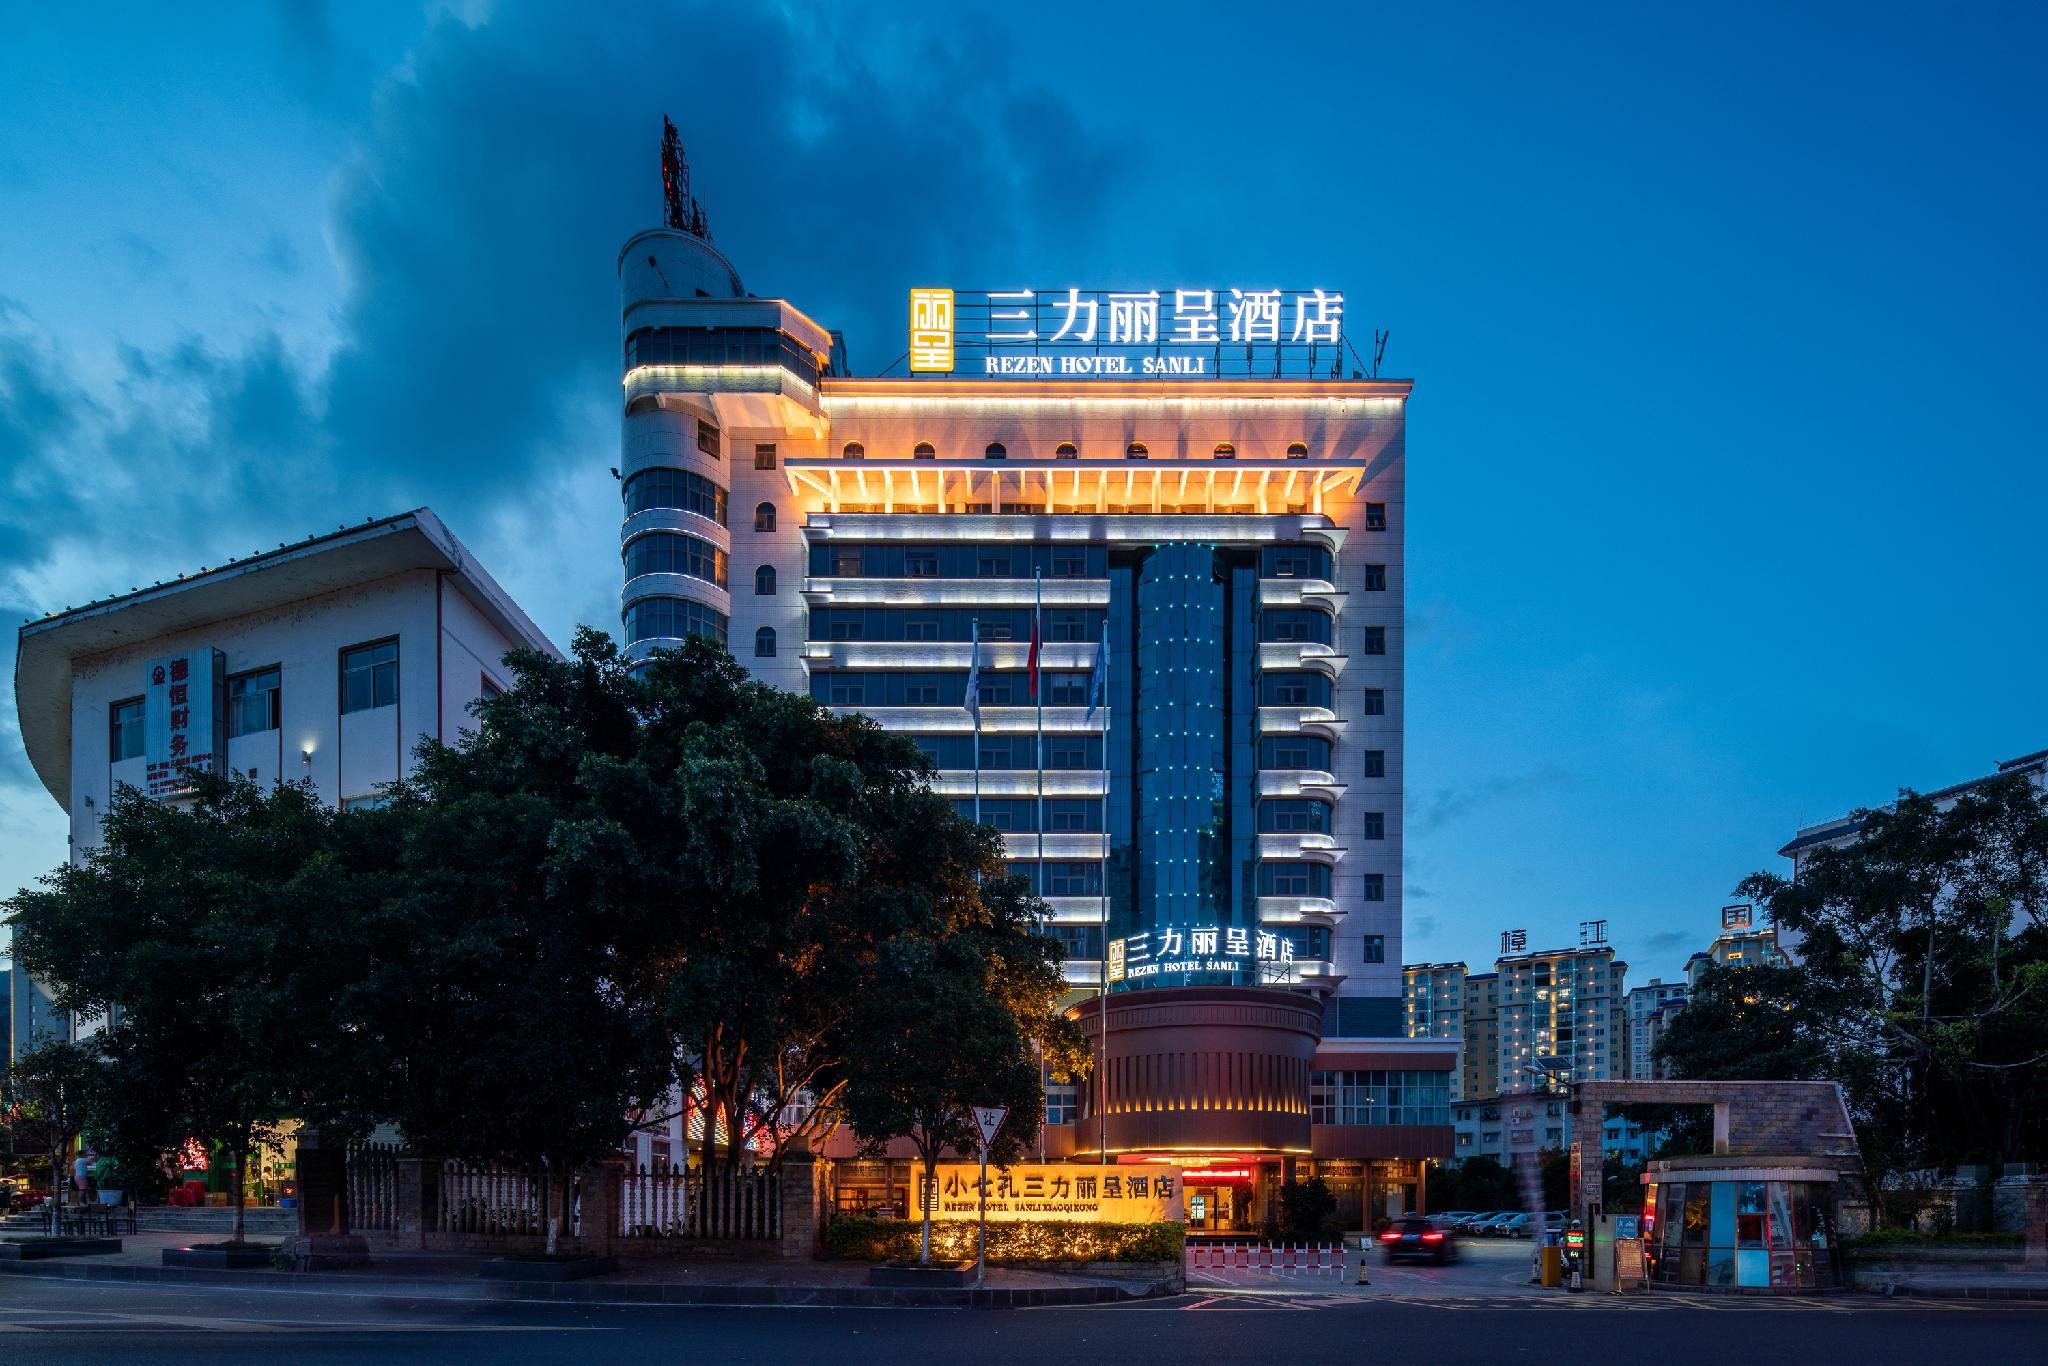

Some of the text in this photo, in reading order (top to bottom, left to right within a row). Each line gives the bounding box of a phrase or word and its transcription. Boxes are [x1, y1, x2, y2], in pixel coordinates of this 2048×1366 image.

[985, 288, 1344, 343] 三力丽呈酒店
[985, 356, 1205, 374] REZEN HOTEL SANLI
[1127, 927, 1294, 965] 三力丽呈酒店
[1127, 961, 1239, 978] REZEN HOTEL SANLI
[983, 1111, 996, 1127] 让
[944, 1201, 976, 1212] REZEN
